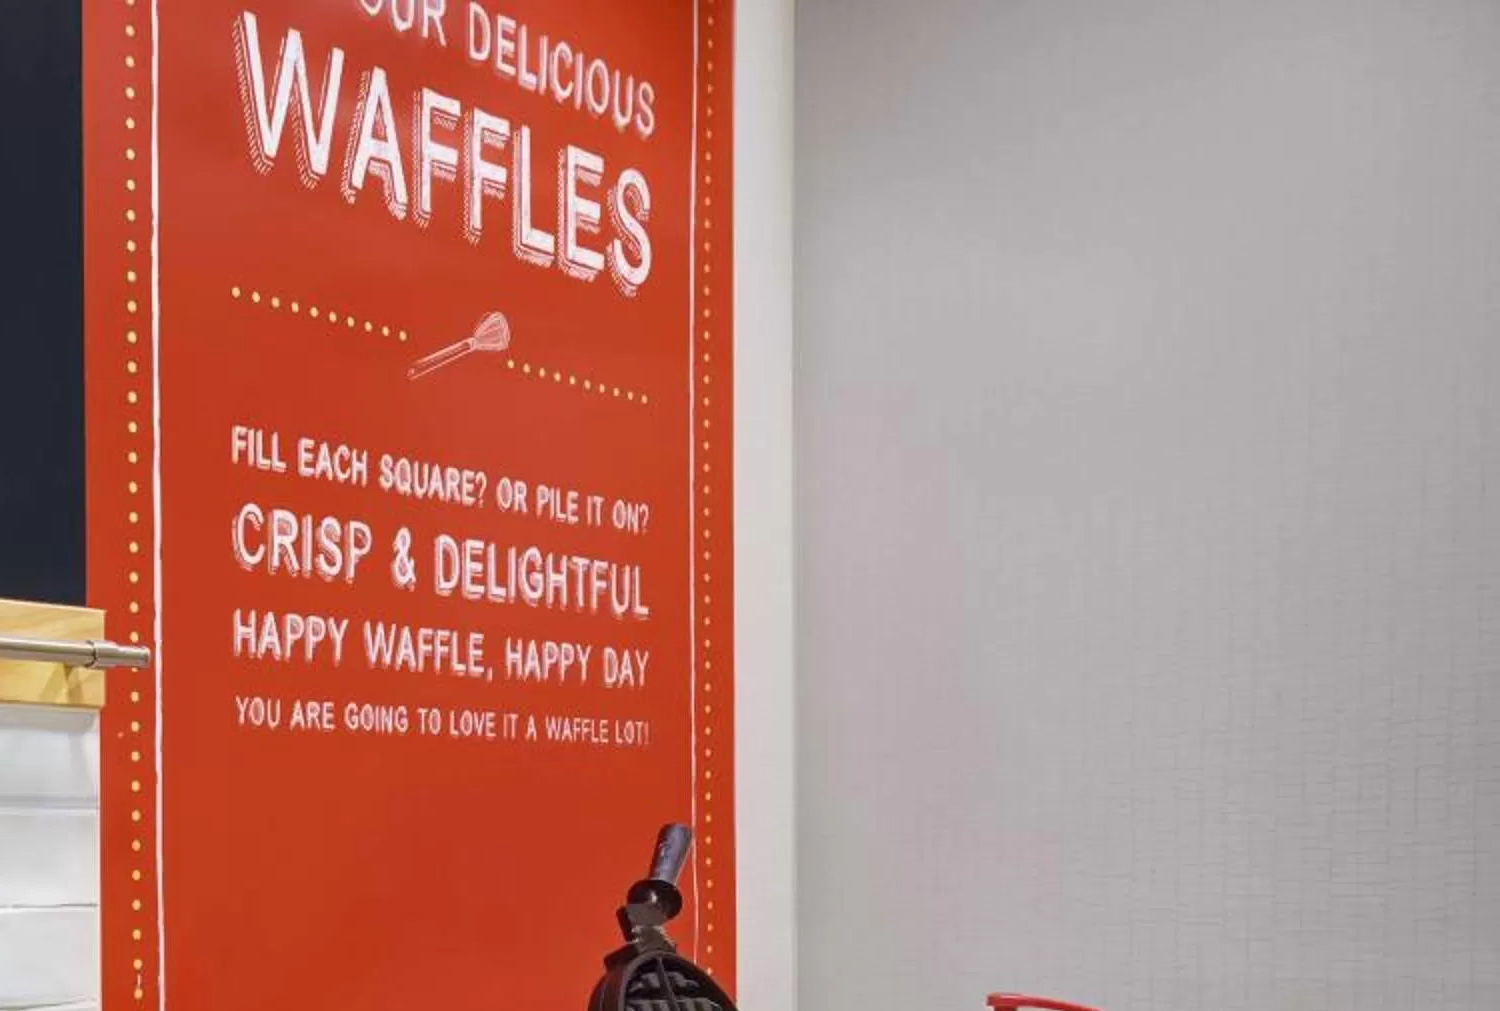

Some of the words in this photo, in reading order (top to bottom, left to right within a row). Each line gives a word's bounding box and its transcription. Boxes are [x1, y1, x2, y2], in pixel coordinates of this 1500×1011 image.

[467, 1, 656, 138] DELICIOUS
[233, 10, 653, 298] WAFFLES
[231, 425, 287, 473] FILL
[297, 437, 368, 487] EACH
[379, 454, 488, 508] SQUARE?
[496, 476, 528, 511] OR
[536, 484, 579, 525] PILE
[587, 495, 605, 528] IT
[612, 499, 650, 535] ON?
[231, 503, 373, 583] CRISP
[391, 527, 417, 590] &
[434, 533, 651, 619] DELIGHTFUL
[232, 609, 349, 666] HAPPY
[363, 620, 494, 681] WAFFLE,
[504, 637, 593, 683] HAPPY
[603, 646, 650, 688] DAY
[235, 695, 282, 729] YOU
[289, 700, 335, 732] ARE
[343, 702, 410, 735] GOING
[418, 707, 442, 735] TO
[449, 710, 497, 738] LOVE
[503, 713, 519, 740] IT
[526, 715, 538, 741] A
[545, 716, 609, 745] WAFFLE
[615, 720, 650, 747] LOT!
